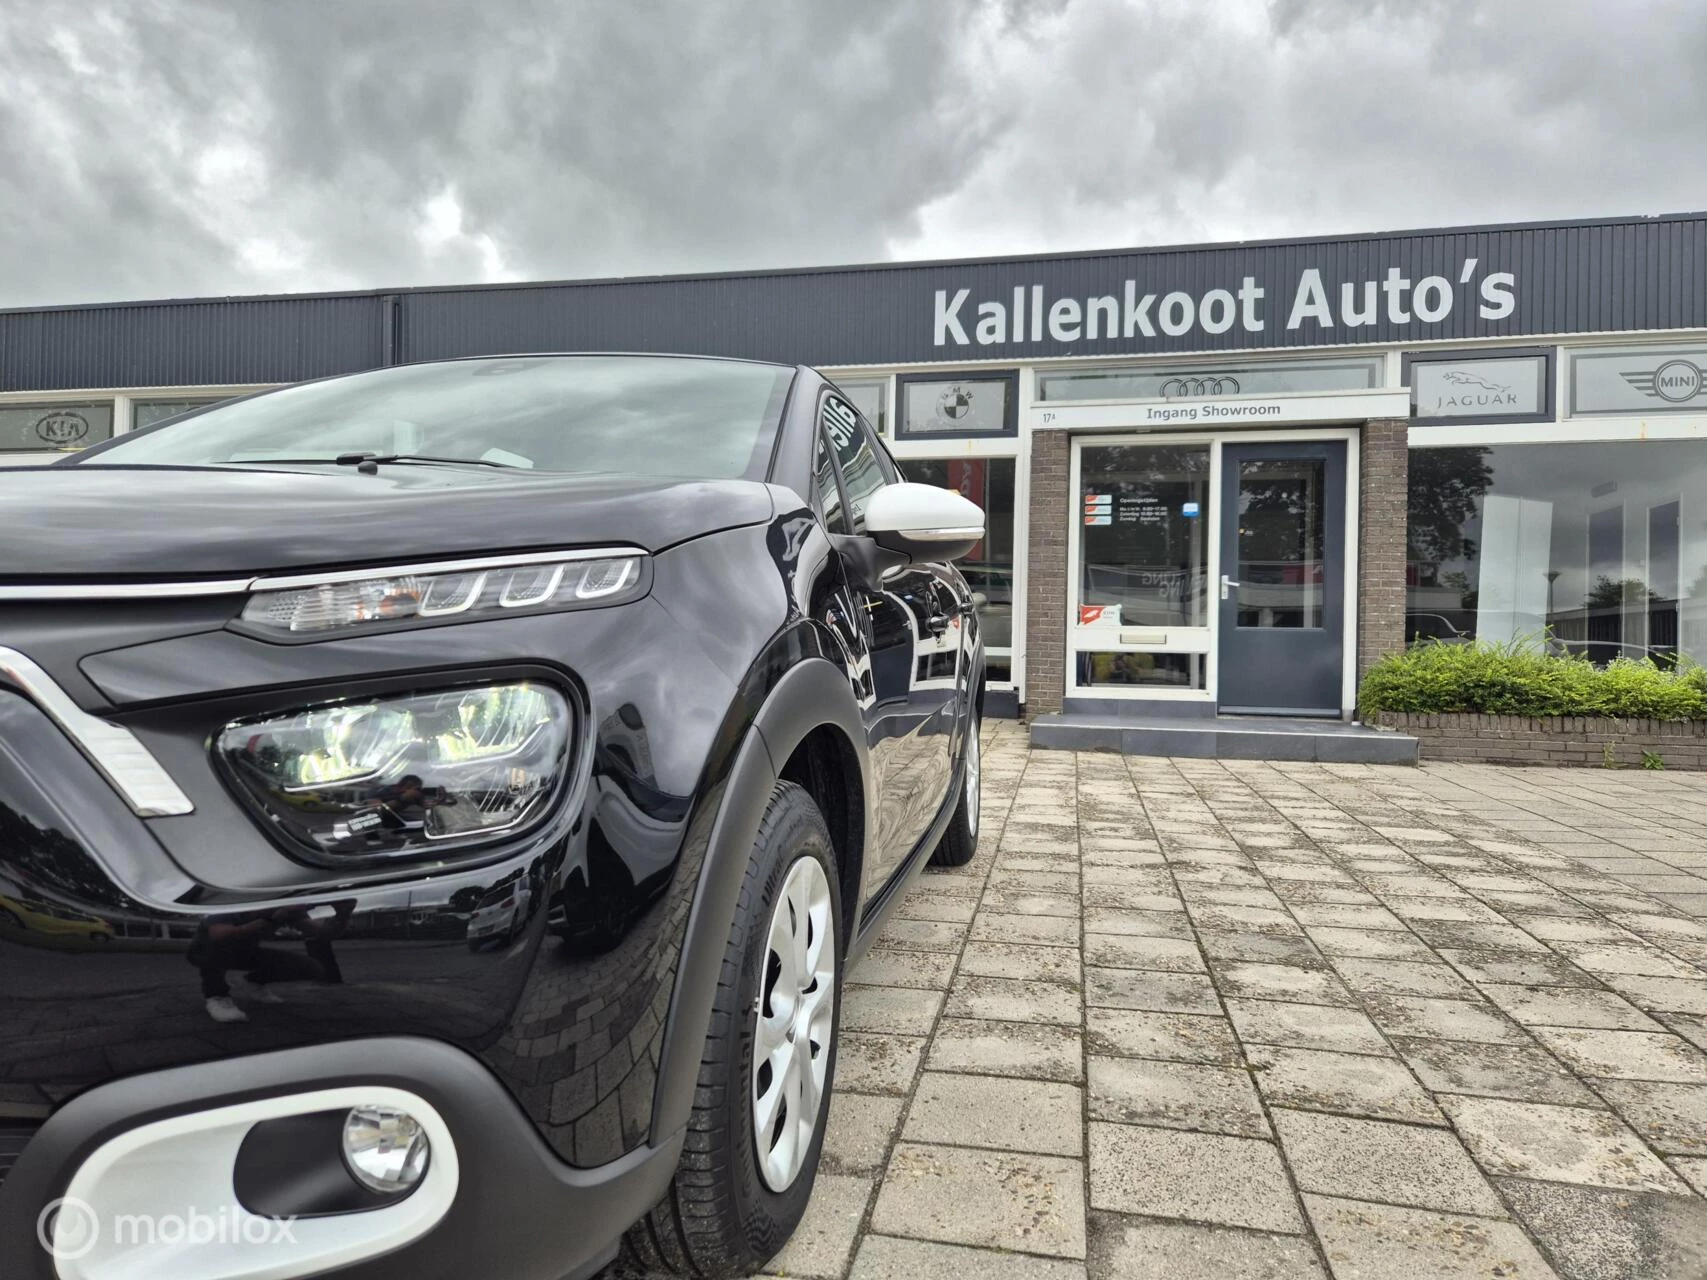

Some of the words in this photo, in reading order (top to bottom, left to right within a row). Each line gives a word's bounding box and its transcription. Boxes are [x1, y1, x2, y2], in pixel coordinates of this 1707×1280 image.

[933, 276, 1265, 346] Kallenkoot
[1286, 258, 1516, 330] Auto's
[1660, 376, 1695, 389] MINI
[1438, 393, 1517, 409] JAGUAR
[1146, 407, 1198, 421] Ingang
[1202, 405, 1281, 417] Showroom
[45, 420, 80, 437] KIA
